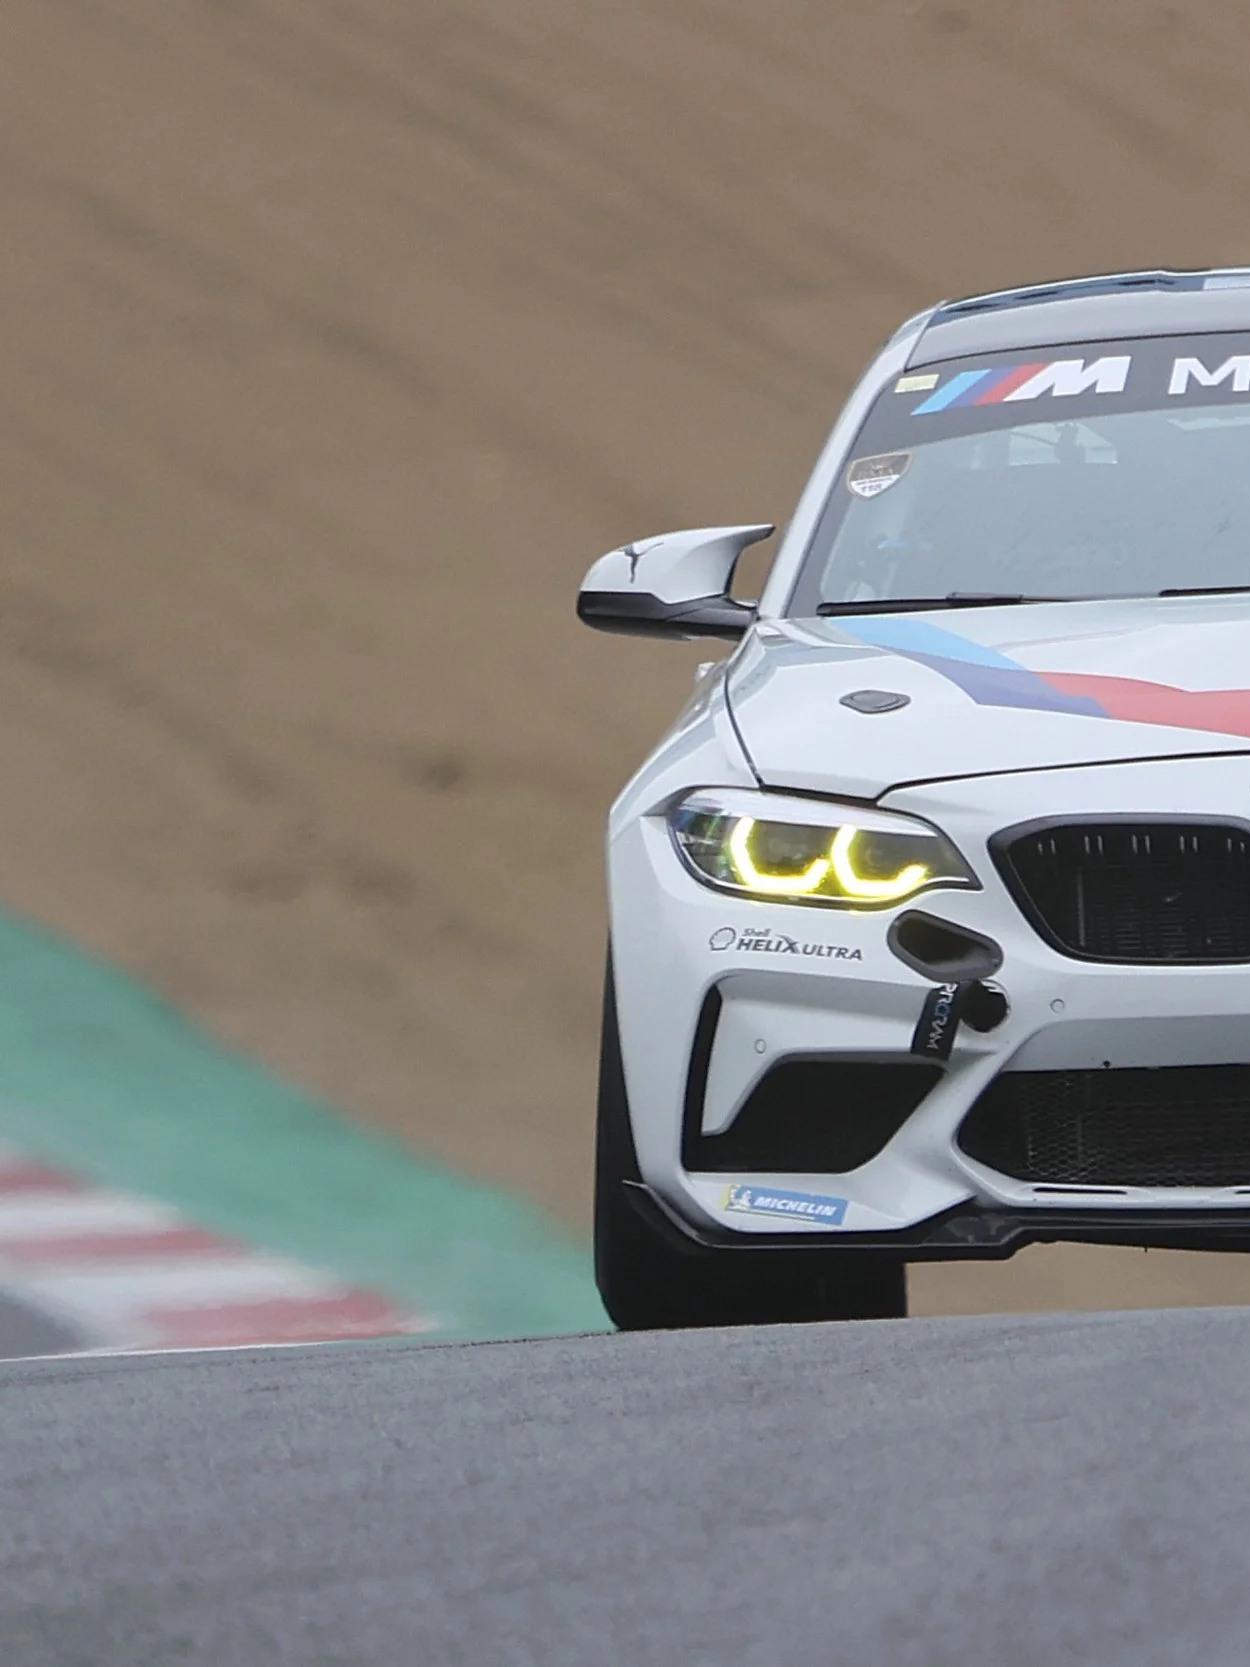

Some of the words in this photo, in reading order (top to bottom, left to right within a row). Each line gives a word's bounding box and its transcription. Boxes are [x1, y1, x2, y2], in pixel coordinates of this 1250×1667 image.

[743, 928, 772, 937] Shell
[736, 934, 800, 953] HELIX
[801, 944, 863, 961] ULTRA
[753, 1196, 838, 1217] MICHELIN
